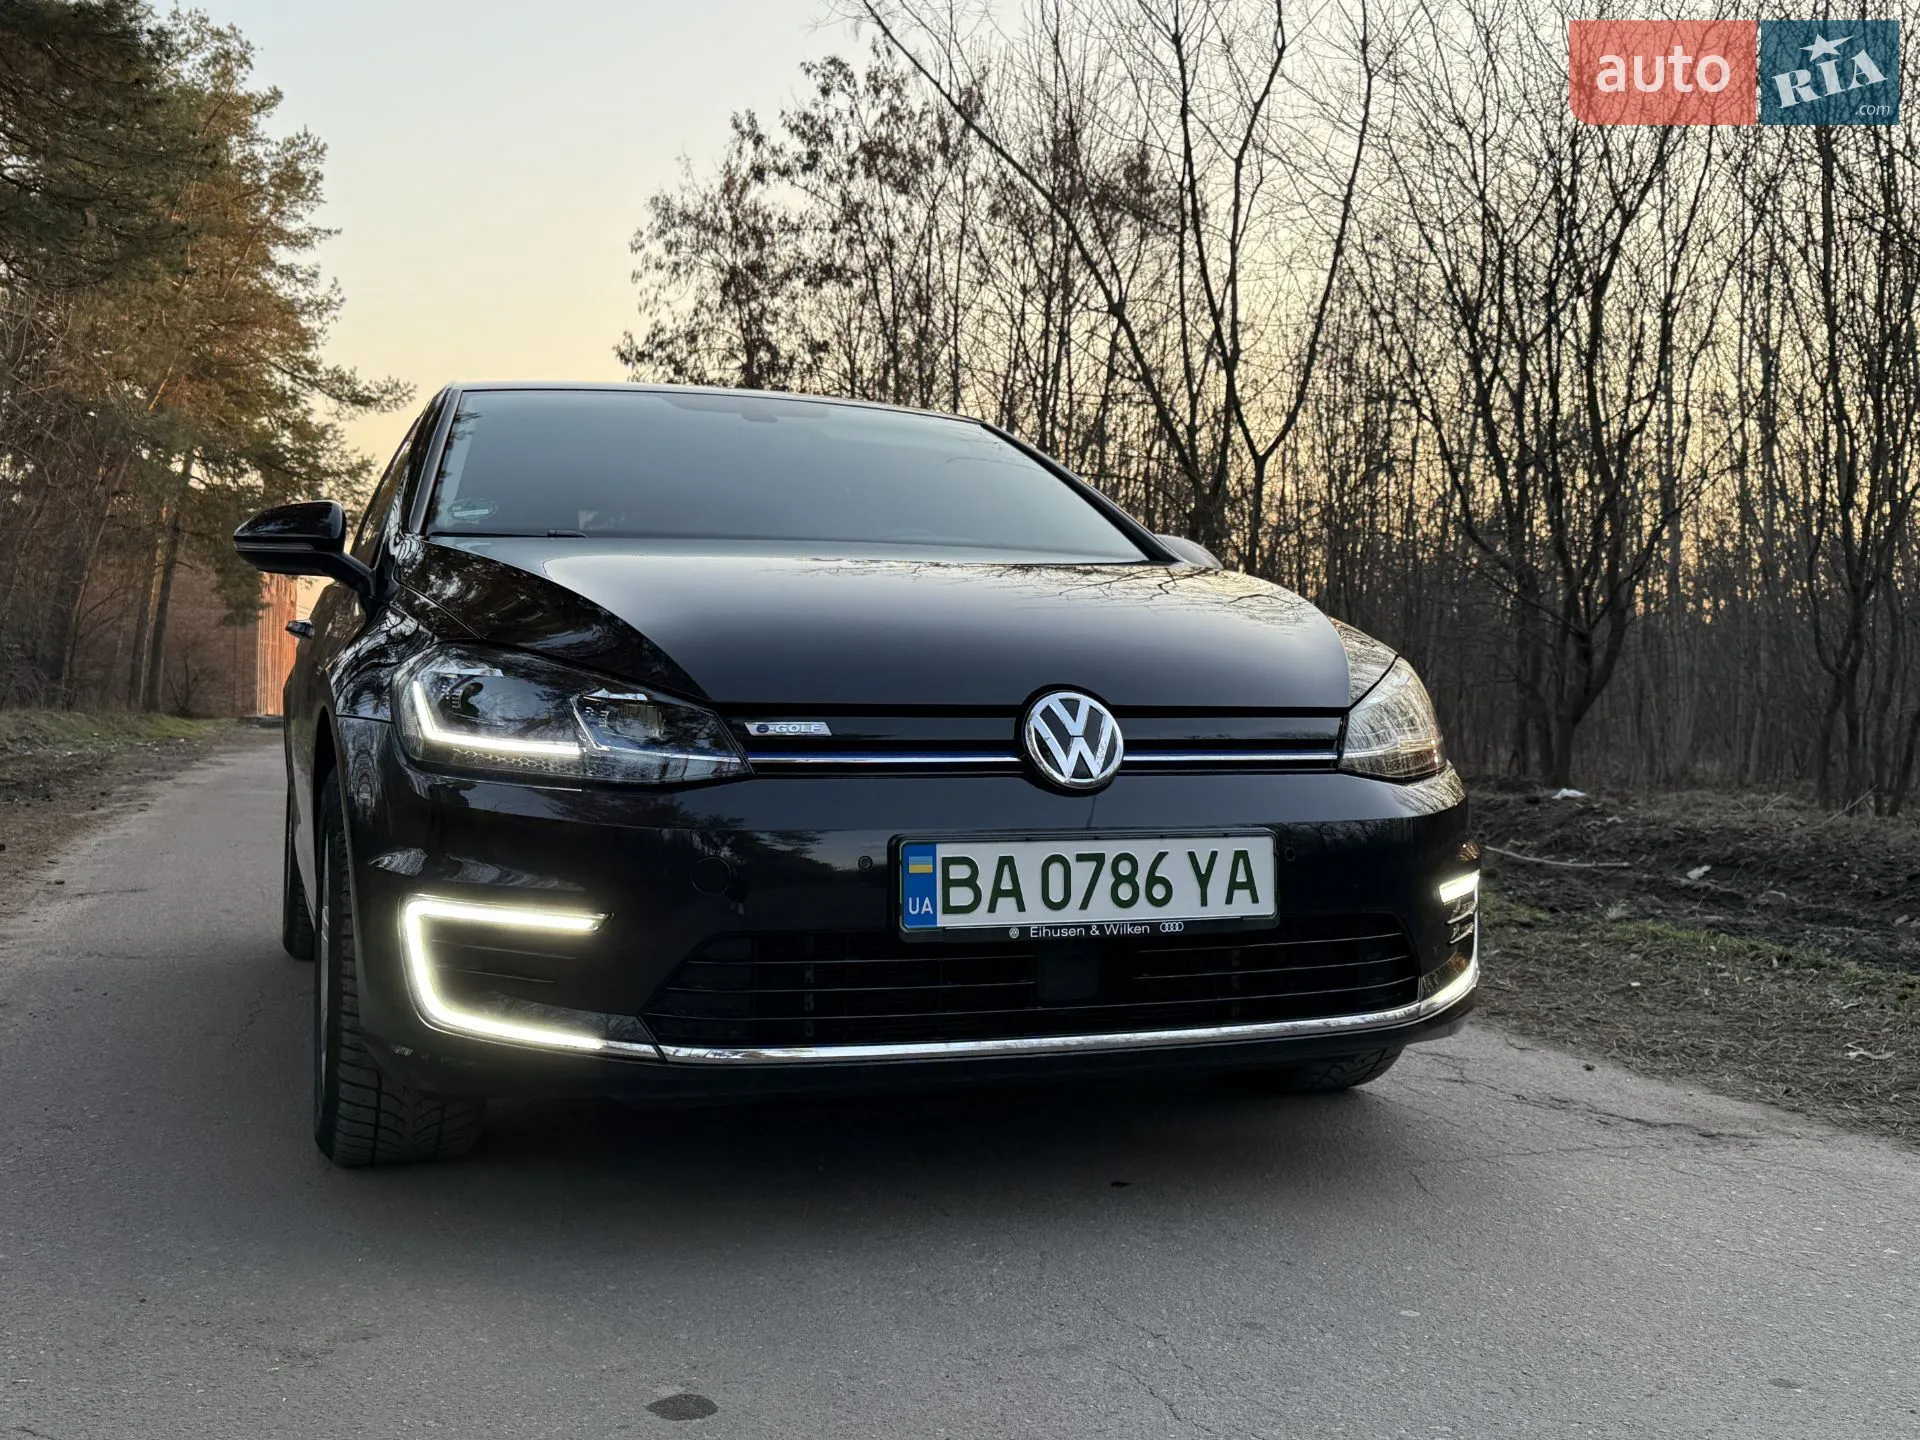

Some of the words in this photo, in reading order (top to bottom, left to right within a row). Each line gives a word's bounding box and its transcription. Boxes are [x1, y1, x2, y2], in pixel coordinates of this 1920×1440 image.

[941, 855, 1026, 915] BA
[1040, 850, 1173, 911] 0786
[1187, 849, 1260, 907] YA
[908, 896, 934, 915] UA
[1029, 925, 1086, 938] Eihusen
[1089, 924, 1101, 936] &
[1104, 923, 1151, 936] Wilken
